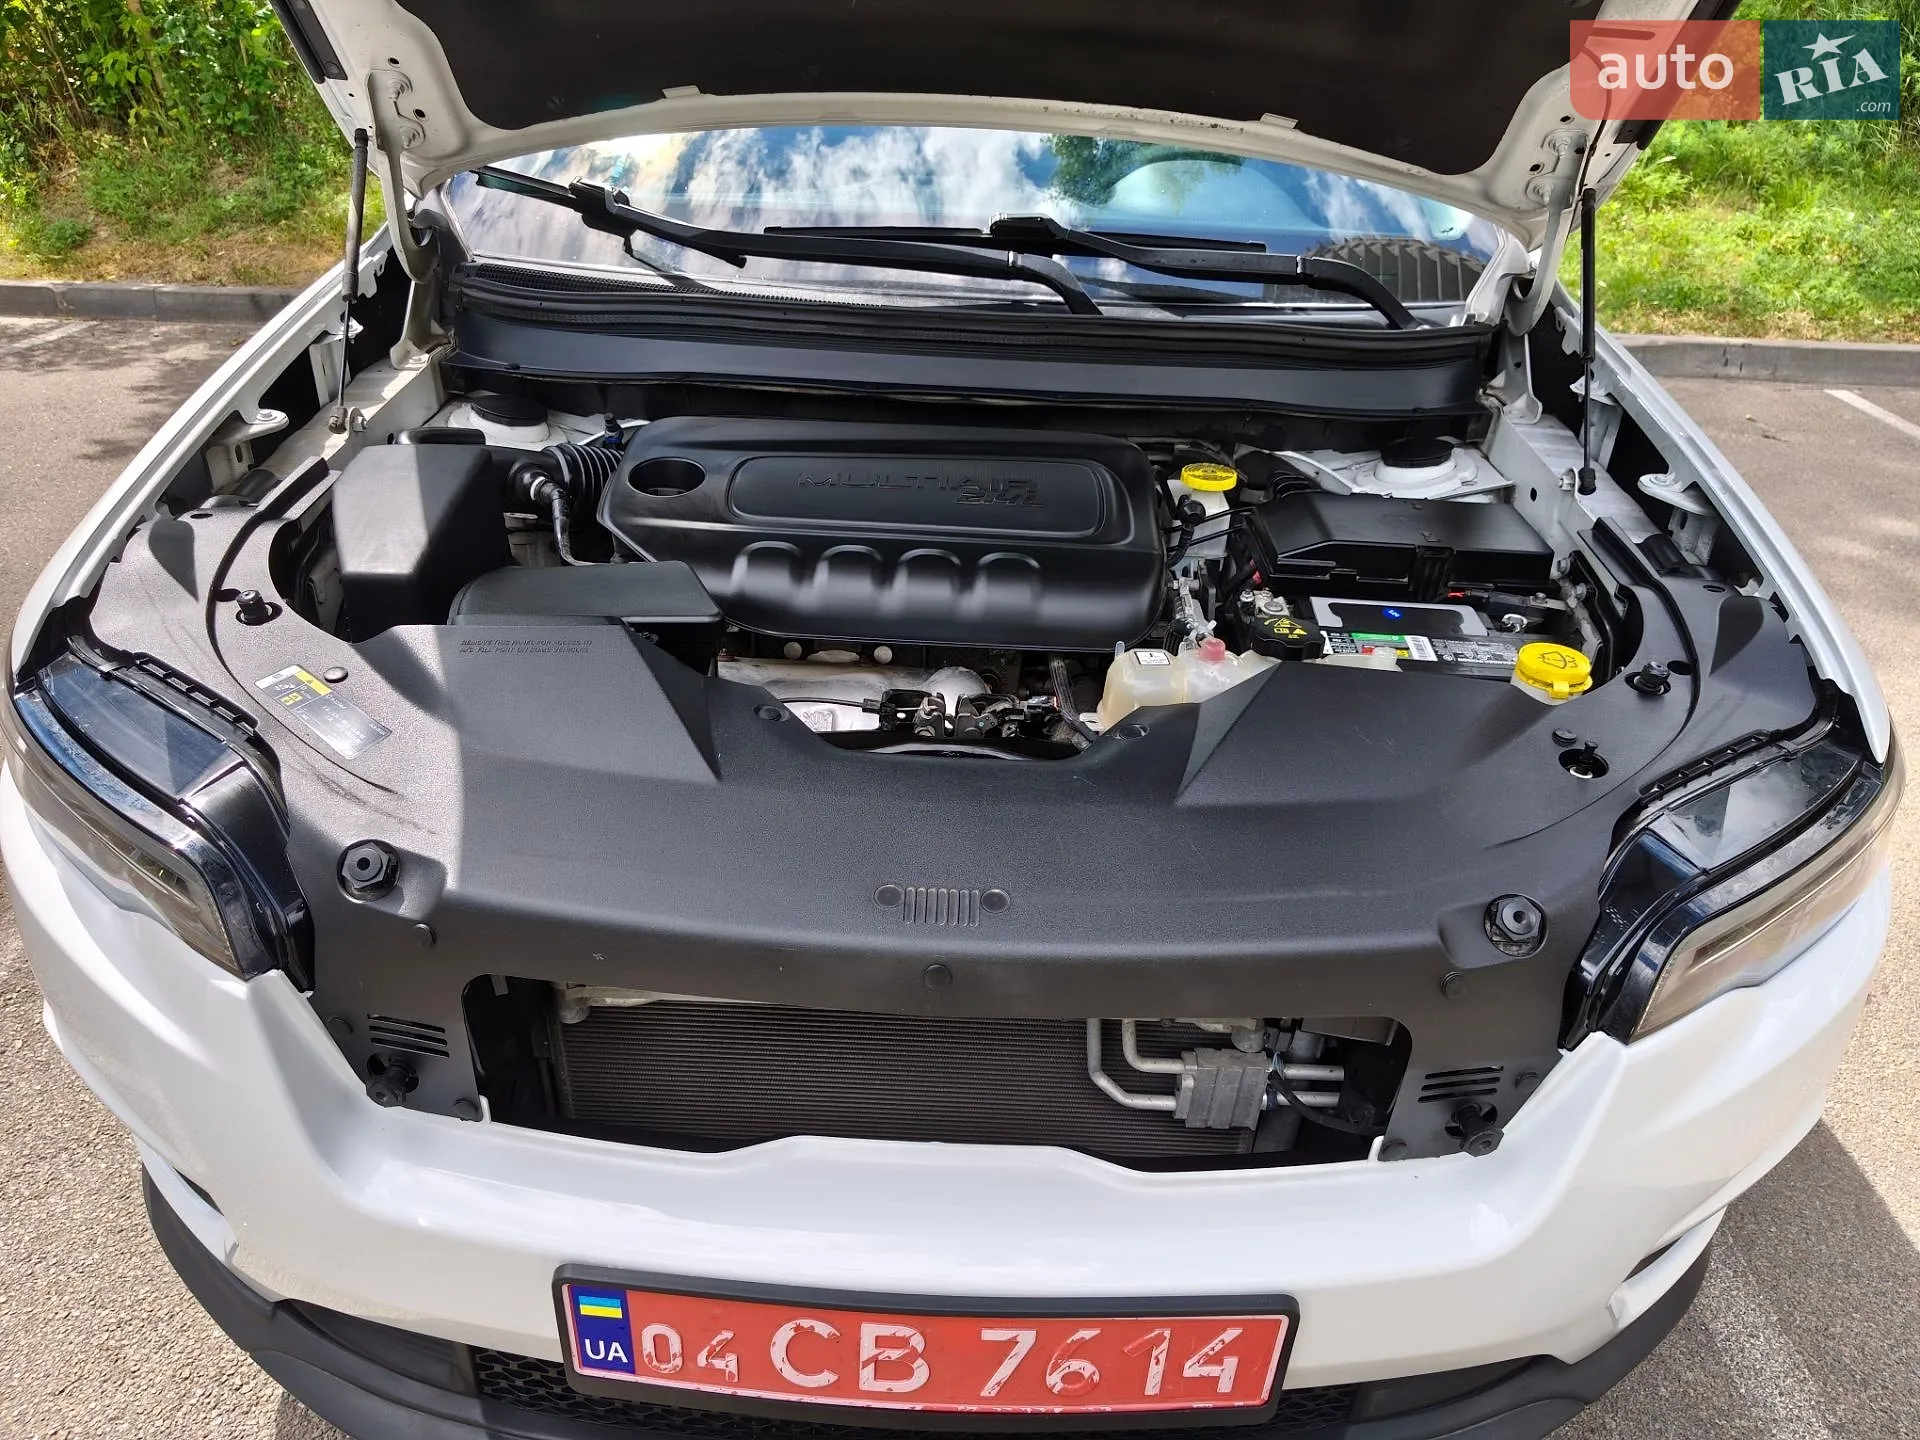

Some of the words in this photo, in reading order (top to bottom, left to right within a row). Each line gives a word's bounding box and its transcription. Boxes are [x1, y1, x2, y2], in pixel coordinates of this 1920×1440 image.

[584, 1338, 629, 1364] UA
[640, 1322, 739, 1384] 04
[769, 1319, 930, 1393] CB
[978, 1327, 1244, 1398] 7614
